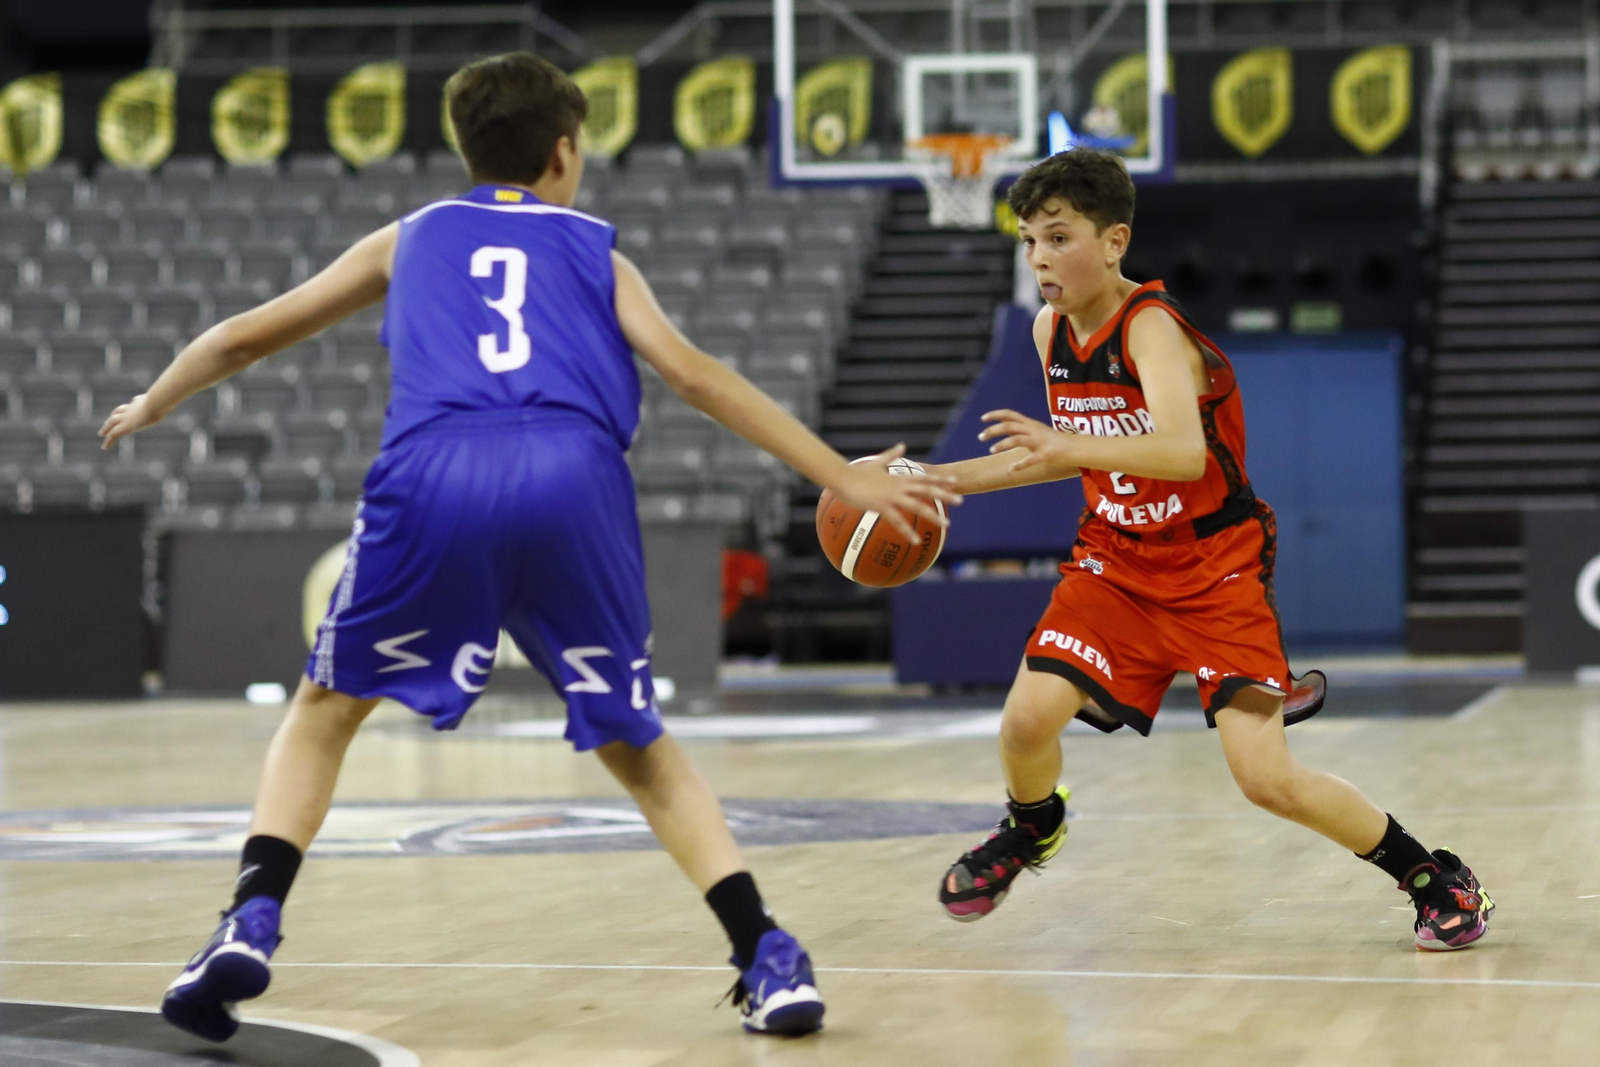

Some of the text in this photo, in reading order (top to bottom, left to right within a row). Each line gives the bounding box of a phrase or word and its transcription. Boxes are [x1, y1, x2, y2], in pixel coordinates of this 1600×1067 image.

[470, 246, 531, 374] 3
[1108, 396, 1127, 410] CB
[1096, 493, 1183, 526] PULEVA
[881, 542, 901, 568] FIBA
